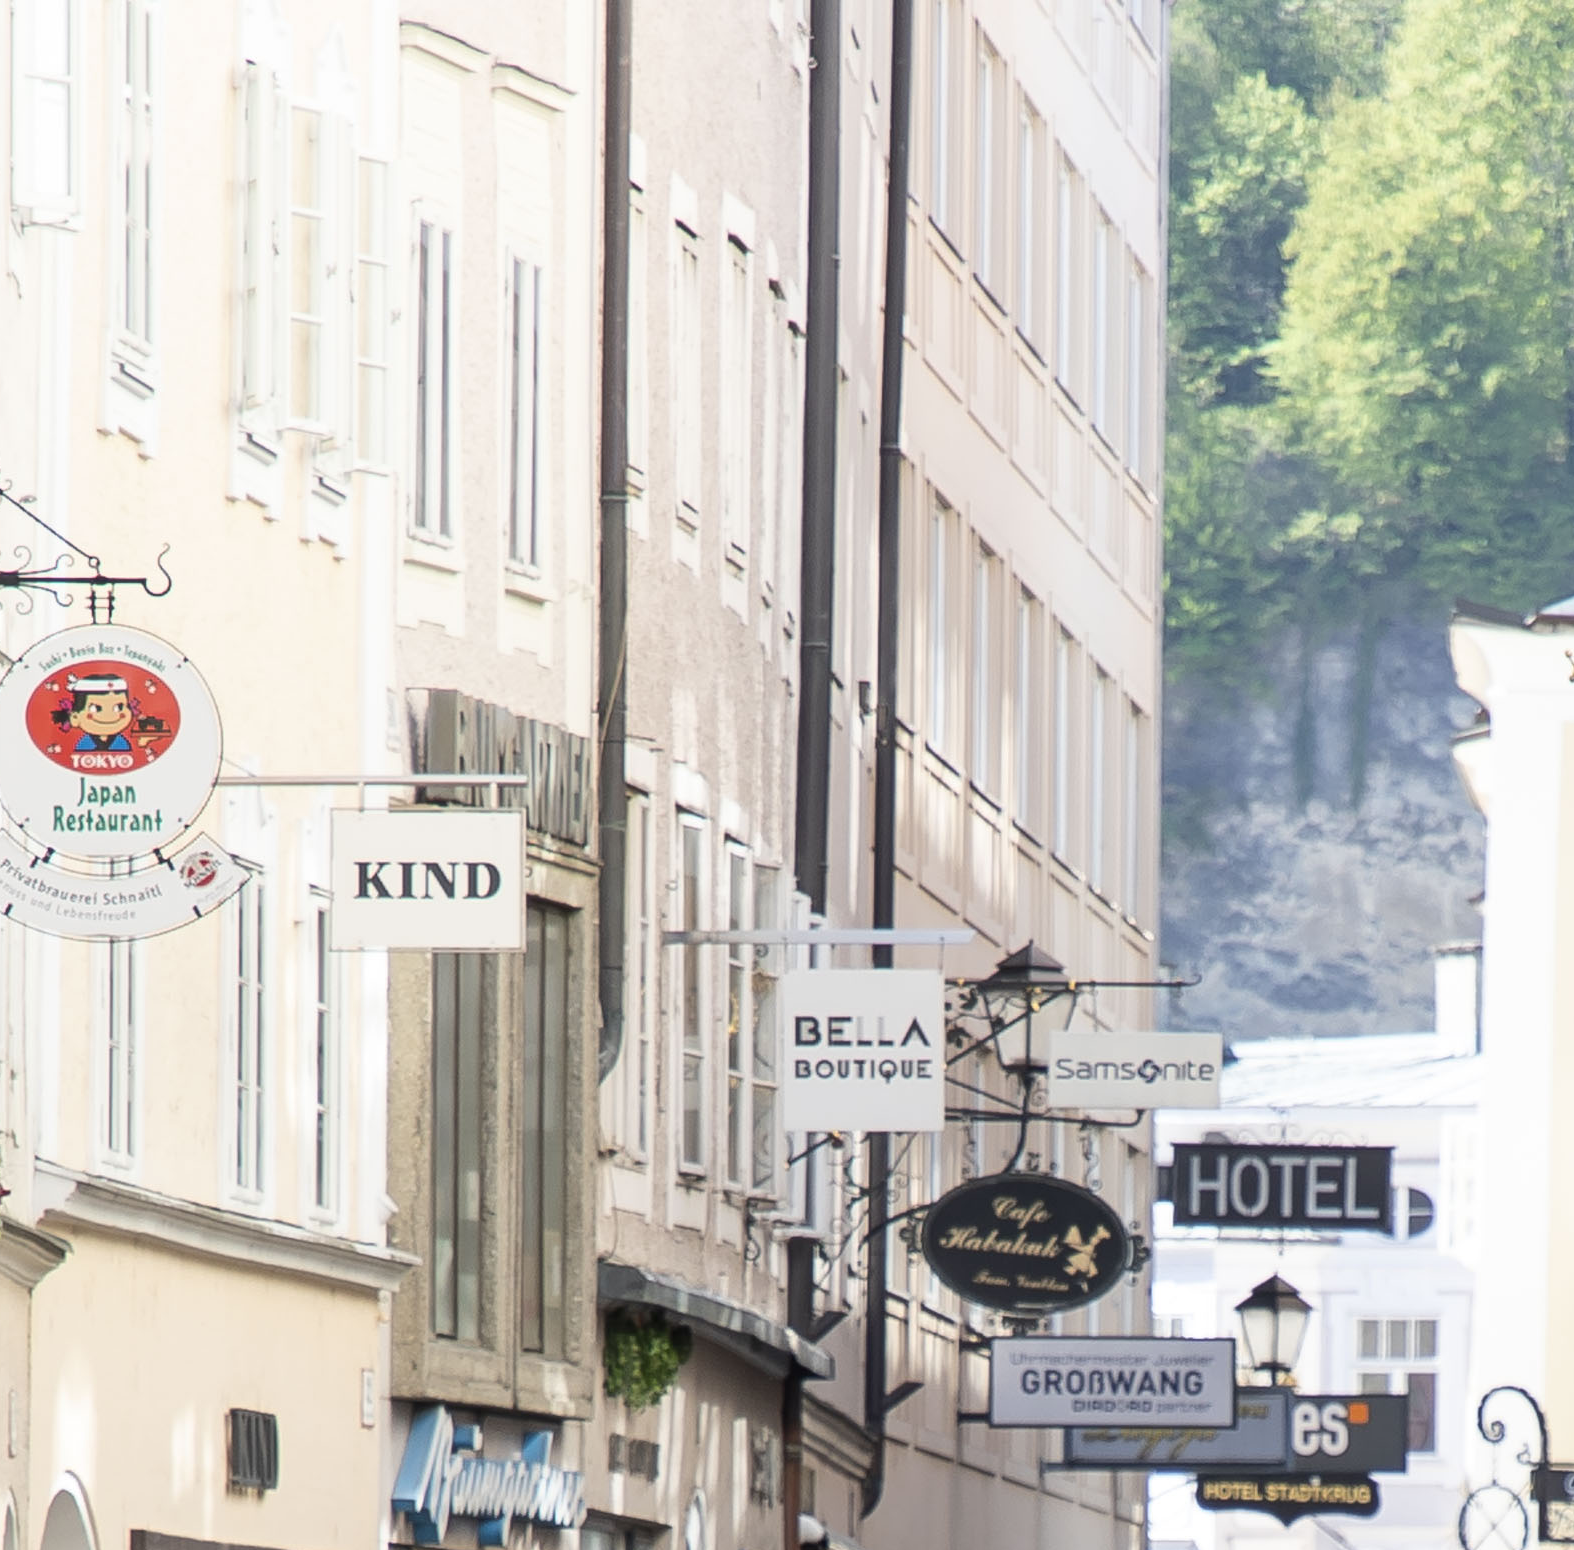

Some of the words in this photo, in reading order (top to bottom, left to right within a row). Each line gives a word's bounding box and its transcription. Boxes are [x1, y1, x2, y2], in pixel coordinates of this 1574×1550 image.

[71, 753, 134, 770] TOKYO
[77, 777, 137, 808] Japan
[53, 806, 164, 833] Restaurant
[0, 858, 98, 906] Privatbrauerei
[102, 883, 163, 906] Schnaitl
[353, 861, 502, 900] KIND
[30, 897, 51, 912] und
[55, 905, 137, 922] Lebensfreude
[794, 1015, 931, 1047] BELLA
[794, 1058, 933, 1084] BOUTIQUE
[1055, 1057, 1216, 1085] Samsonite
[1188, 1155, 1380, 1220] HOTEL
[939, 1225, 1064, 1259] Habakuk
[1020, 1368, 1205, 1396] GROßWANG
[1291, 1401, 1350, 1457] es
[1203, 1480, 1265, 1501] HOTEL
[1265, 1482, 1372, 1505] STADTKRUG
